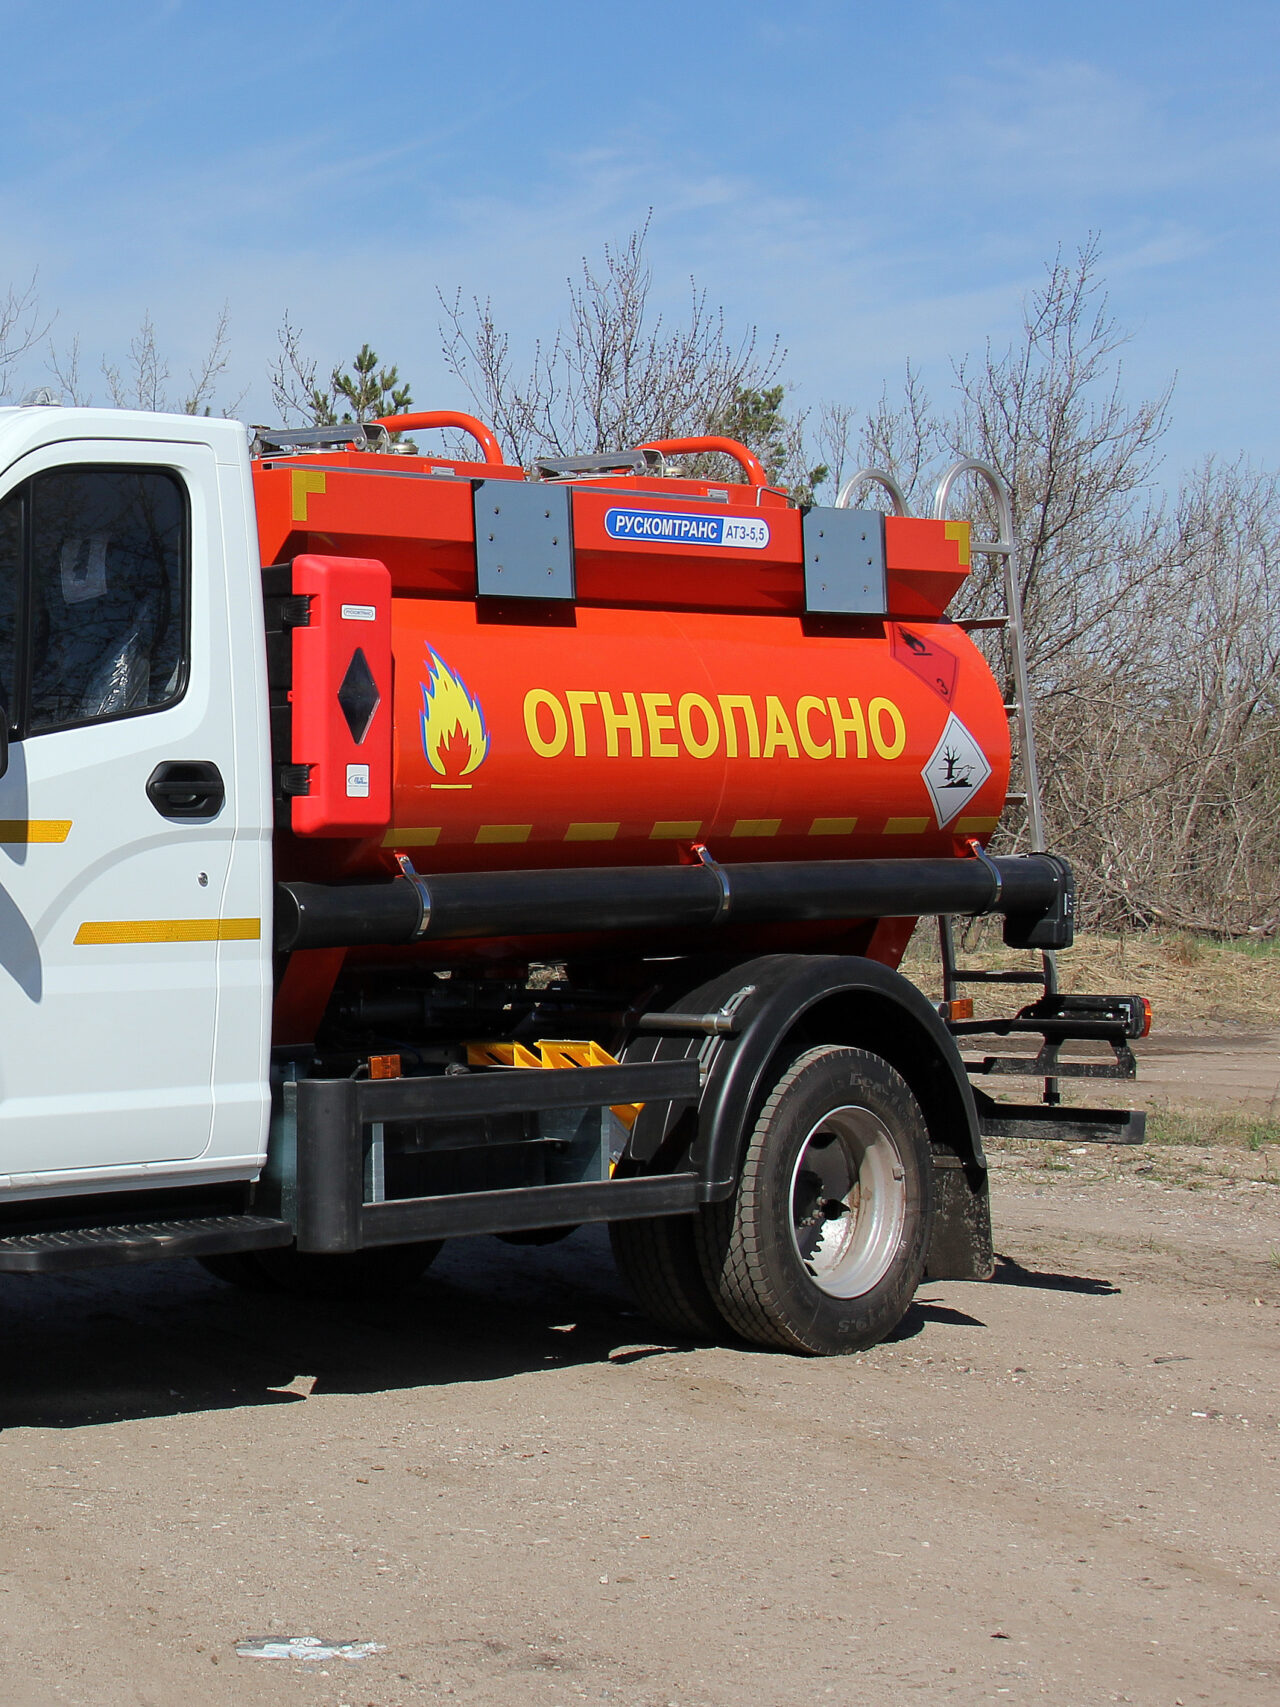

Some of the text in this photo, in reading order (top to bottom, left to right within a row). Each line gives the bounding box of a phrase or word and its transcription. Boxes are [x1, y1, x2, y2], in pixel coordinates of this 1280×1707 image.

[615, 514, 718, 539] РУСКОМТРАНС
[936, 678, 949, 695] 3
[523, 688, 907, 760] ОГНЕОПАСНО
